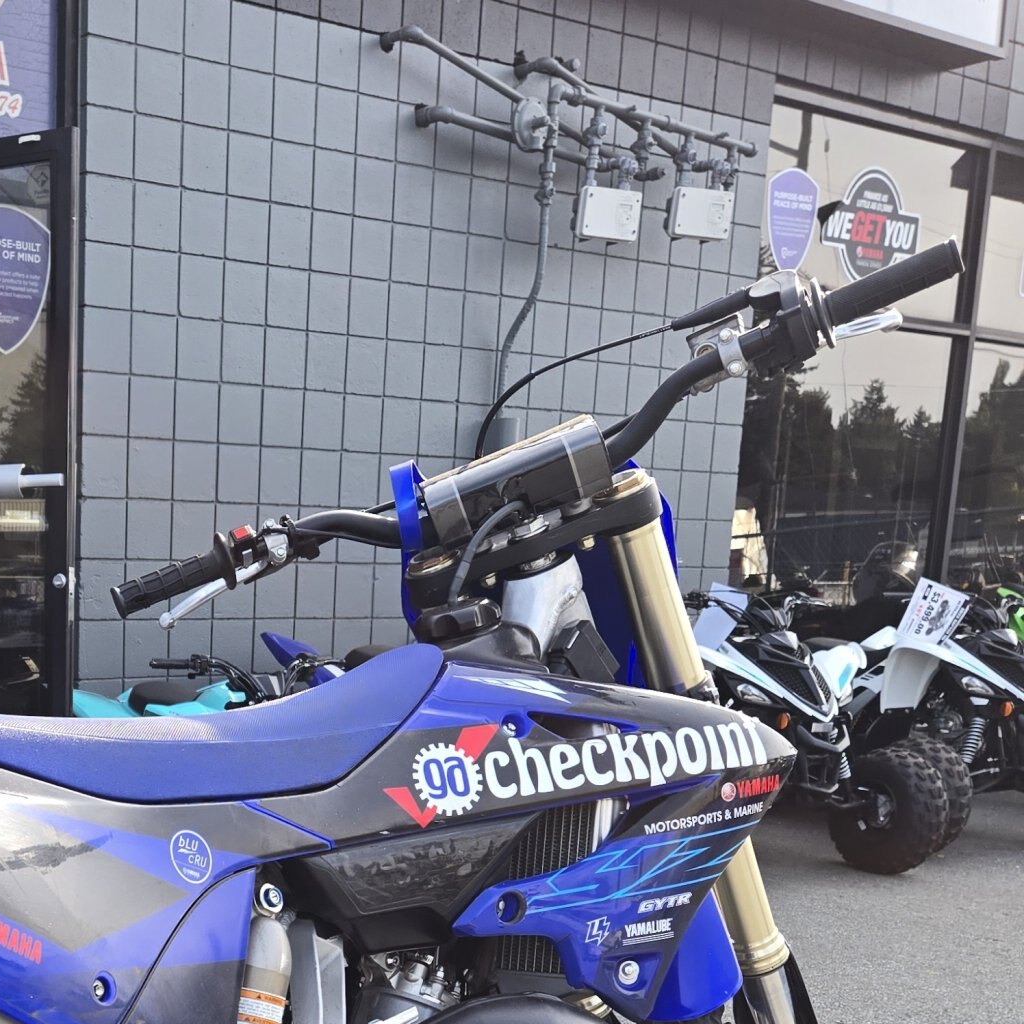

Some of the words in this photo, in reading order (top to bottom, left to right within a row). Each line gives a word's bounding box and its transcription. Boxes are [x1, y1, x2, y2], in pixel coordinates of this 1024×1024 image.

[827, 210, 855, 240] WE
[851, 211, 887, 244] GET
[884, 219, 915, 249] YOU
[2, 251, 15, 260] OF
[17, 252, 41, 264] MIND
[484, 721, 768, 799] checkpoint
[736, 774, 781, 797] YAMAHA
[644, 811, 722, 835] MOTORSPORTS
[724, 808, 732, 818] &
[734, 801, 764, 817] MARINE
[637, 891, 692, 914] GYTR
[624, 918, 673, 938] YAMALUBE
